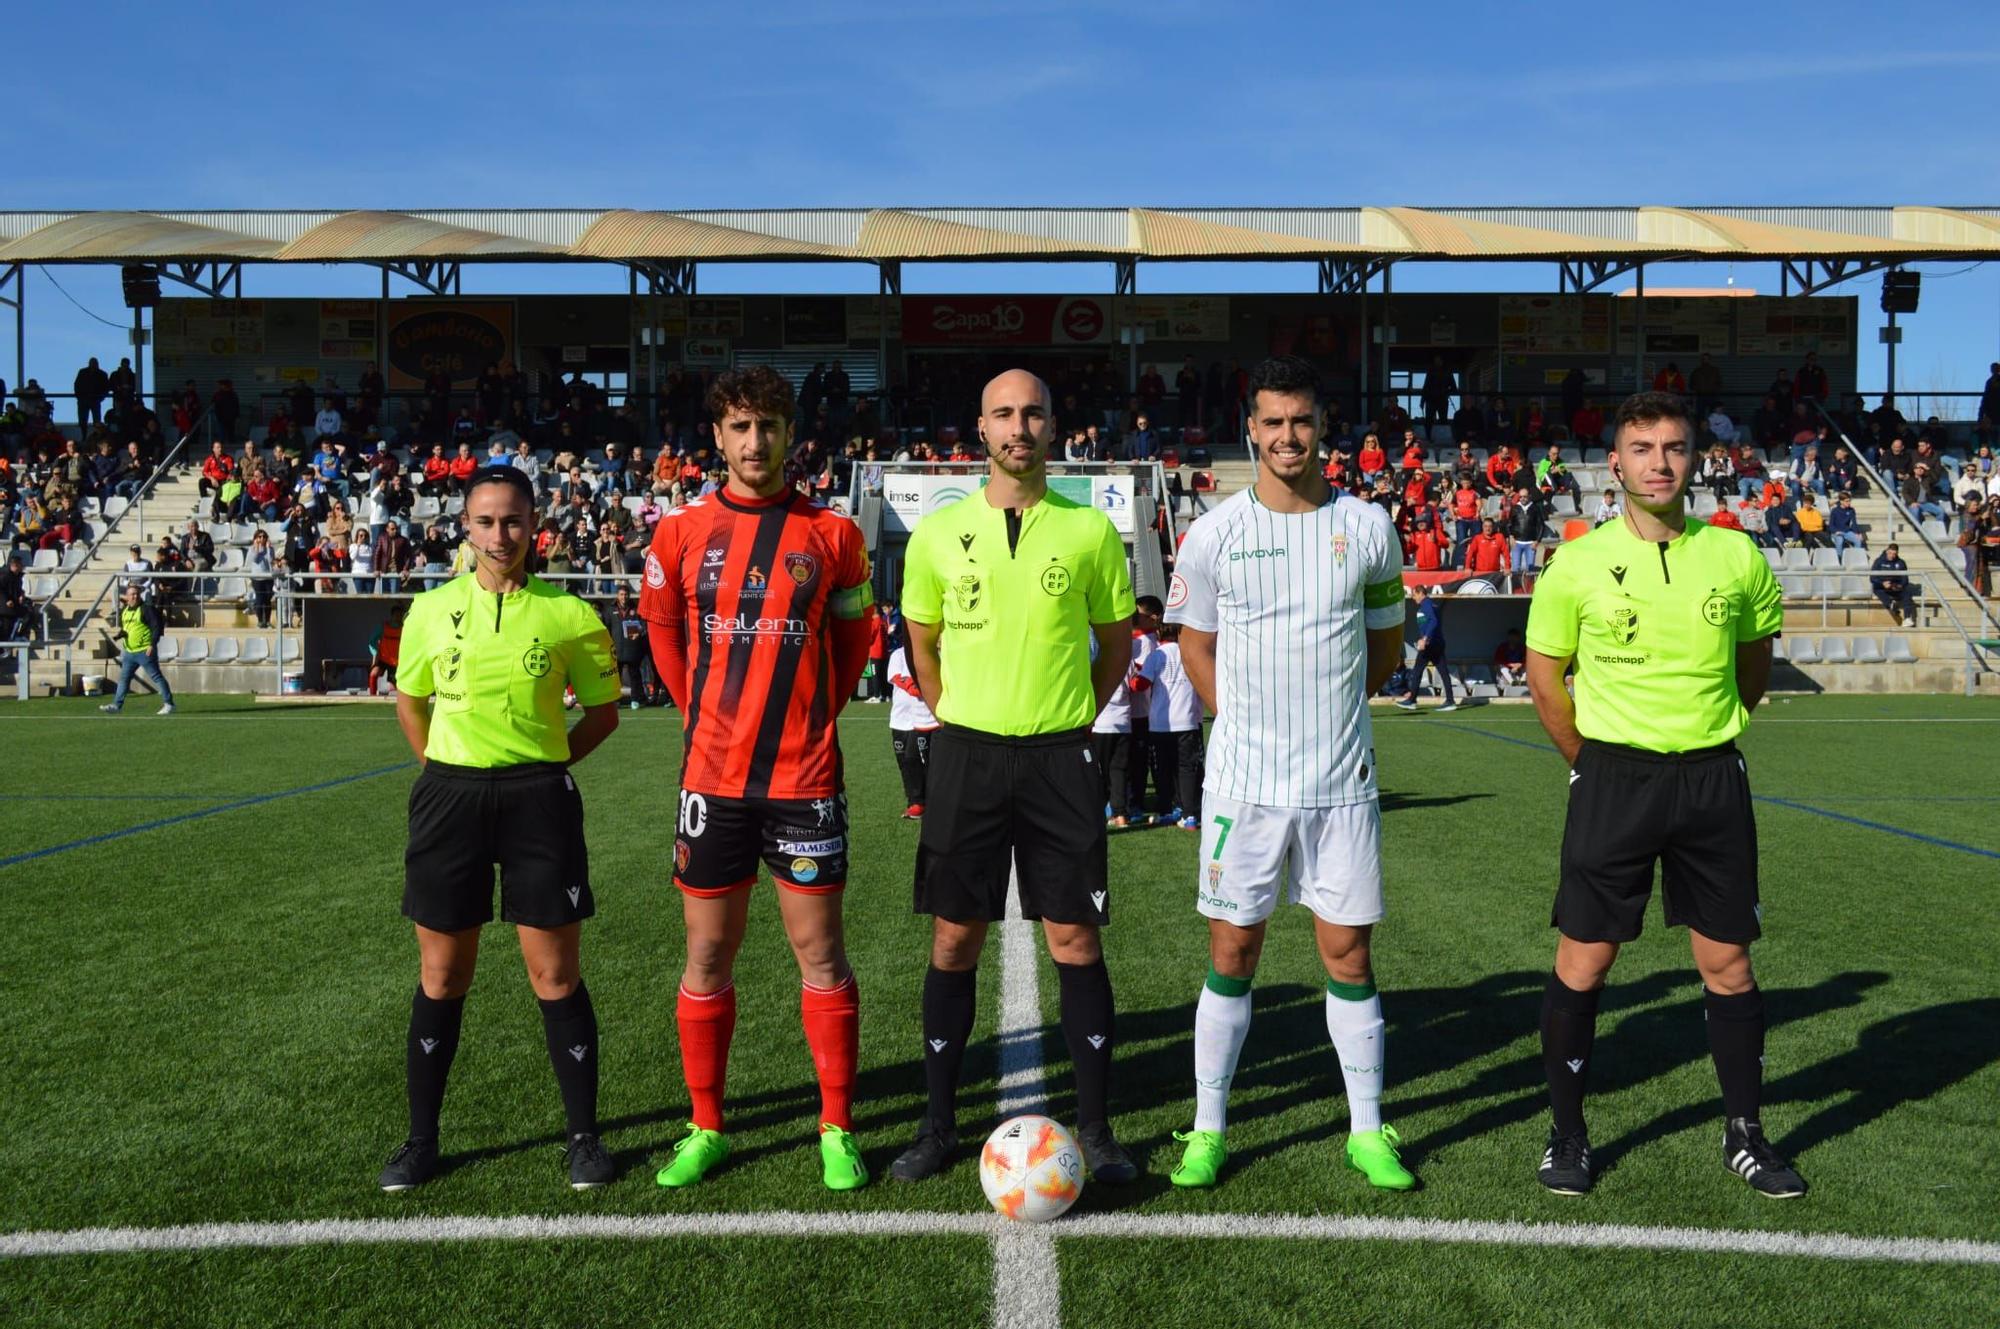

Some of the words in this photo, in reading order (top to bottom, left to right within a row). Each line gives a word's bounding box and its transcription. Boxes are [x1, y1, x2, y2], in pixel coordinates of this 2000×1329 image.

[889, 490, 919, 502] imsc
[1229, 548, 1286, 561] GIVOVA
[705, 635, 812, 646] COSMETICS
[1594, 652, 1645, 665] matchapp
[679, 788, 708, 838] 10
[1213, 815, 1234, 861] 7
